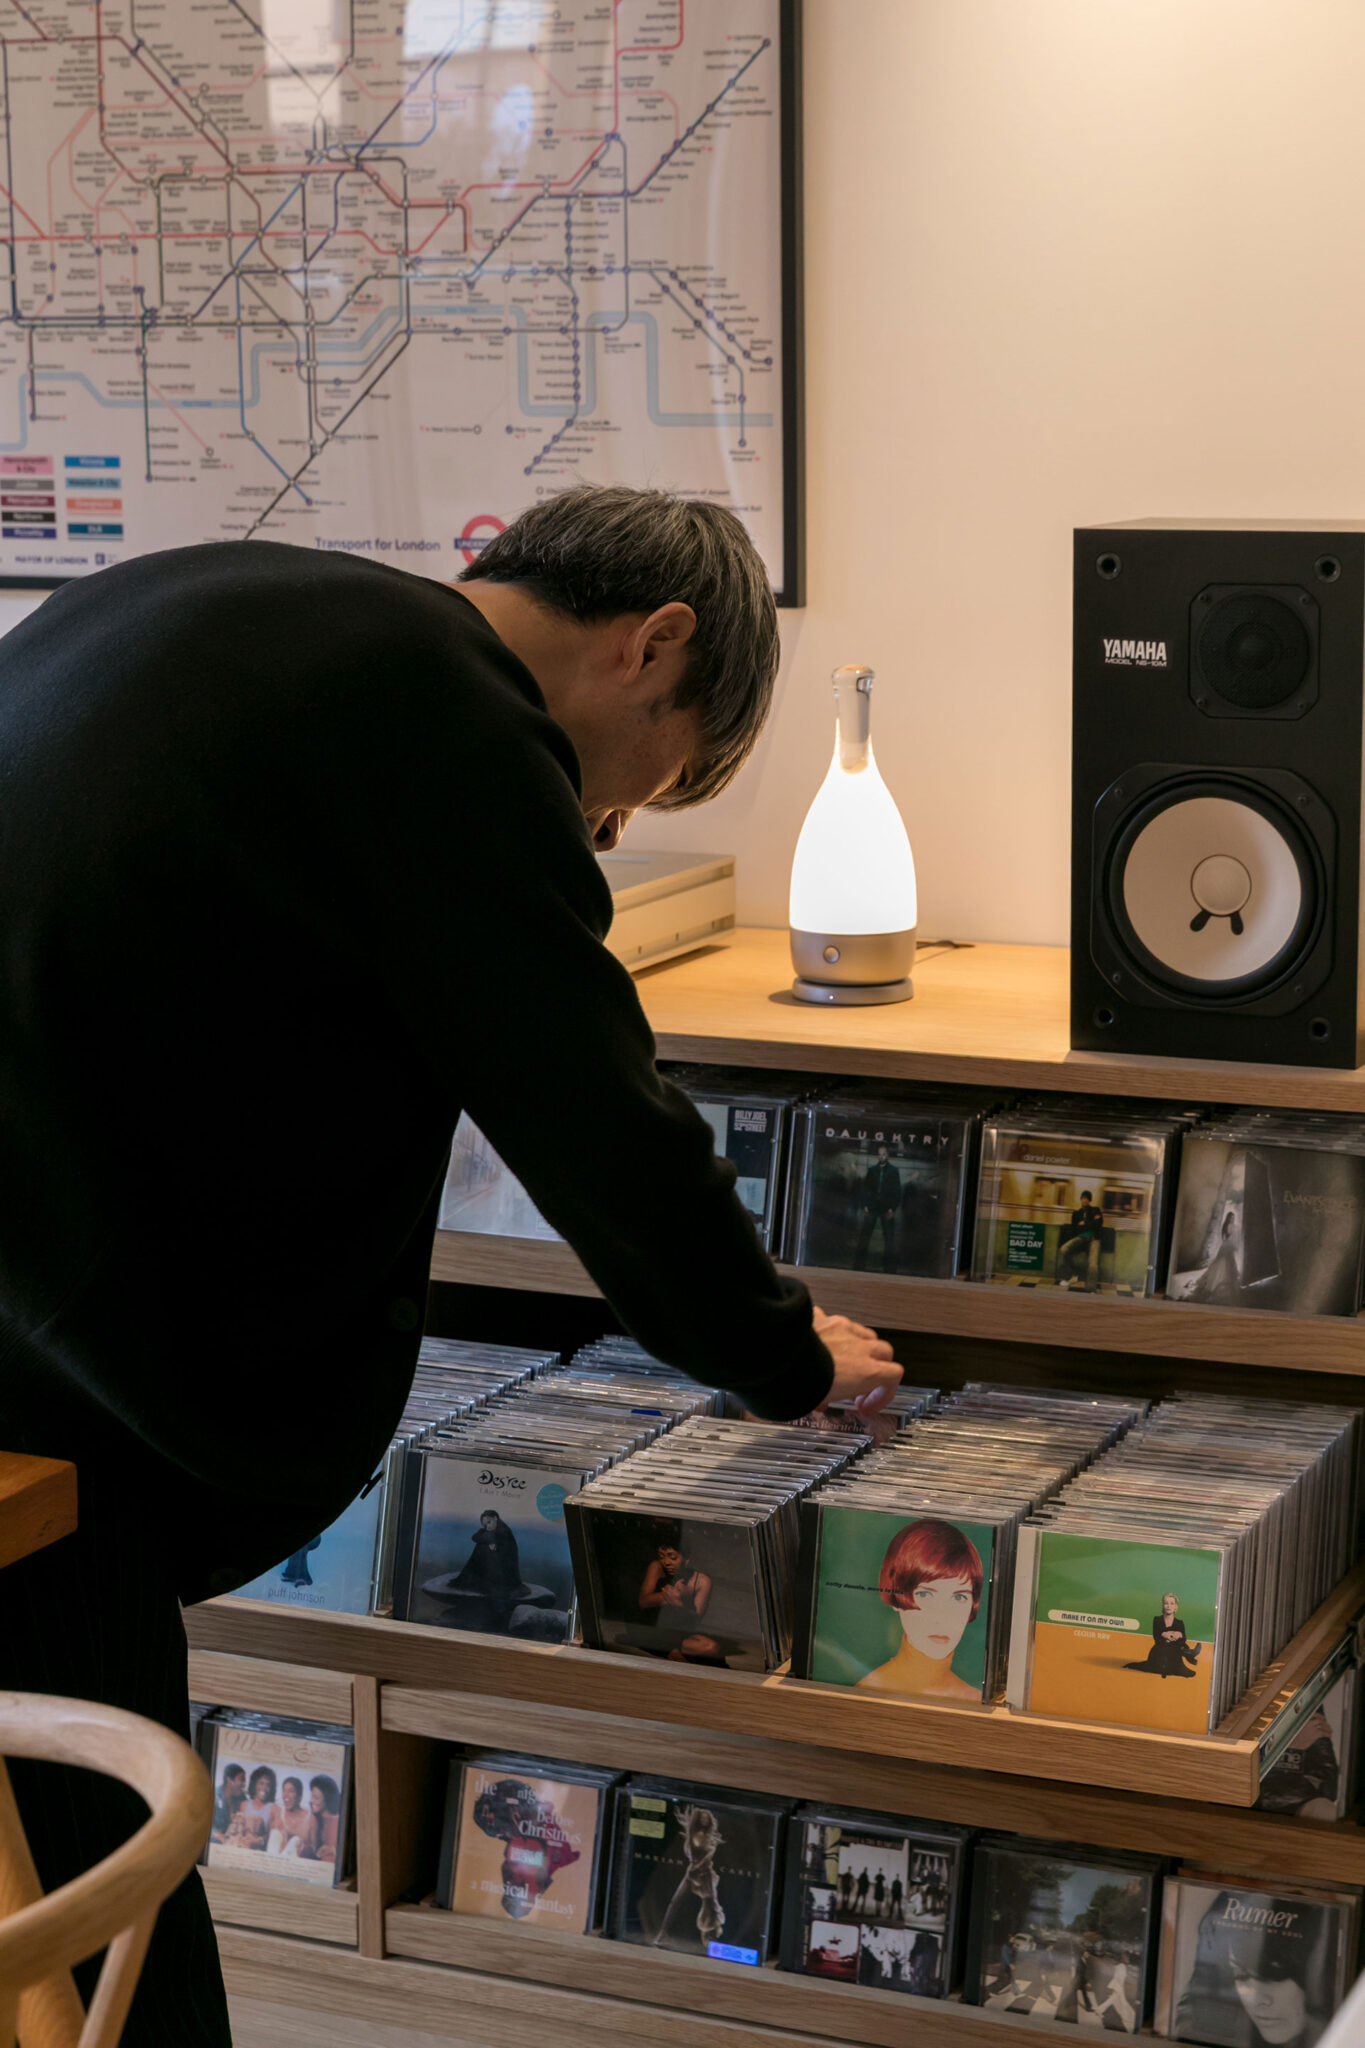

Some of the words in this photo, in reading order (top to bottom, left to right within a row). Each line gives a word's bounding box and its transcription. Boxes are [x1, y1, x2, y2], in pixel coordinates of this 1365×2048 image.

[314, 537, 371, 552] Transport
[374, 537, 392, 550] for
[394, 539, 441, 552] London
[1103, 638, 1167, 661] YAMAHA
[1104, 657, 1133, 665] MODEL
[735, 1109, 752, 1120] BILLY
[751, 1111, 767, 1122] JOEL
[825, 1127, 950, 1145] DAUGHTRY
[1009, 1239, 1026, 1248] BAD
[1027, 1240, 1044, 1250] DAY
[1061, 1612, 1079, 1621] MAKE
[1109, 1619, 1125, 1627] OWN
[474, 1774, 498, 1796] the
[518, 1820, 582, 1845] Christmas
[480, 1880, 529, 1899] musical
[534, 1893, 577, 1920] fantasy
[1221, 1897, 1299, 1929] Rumer
